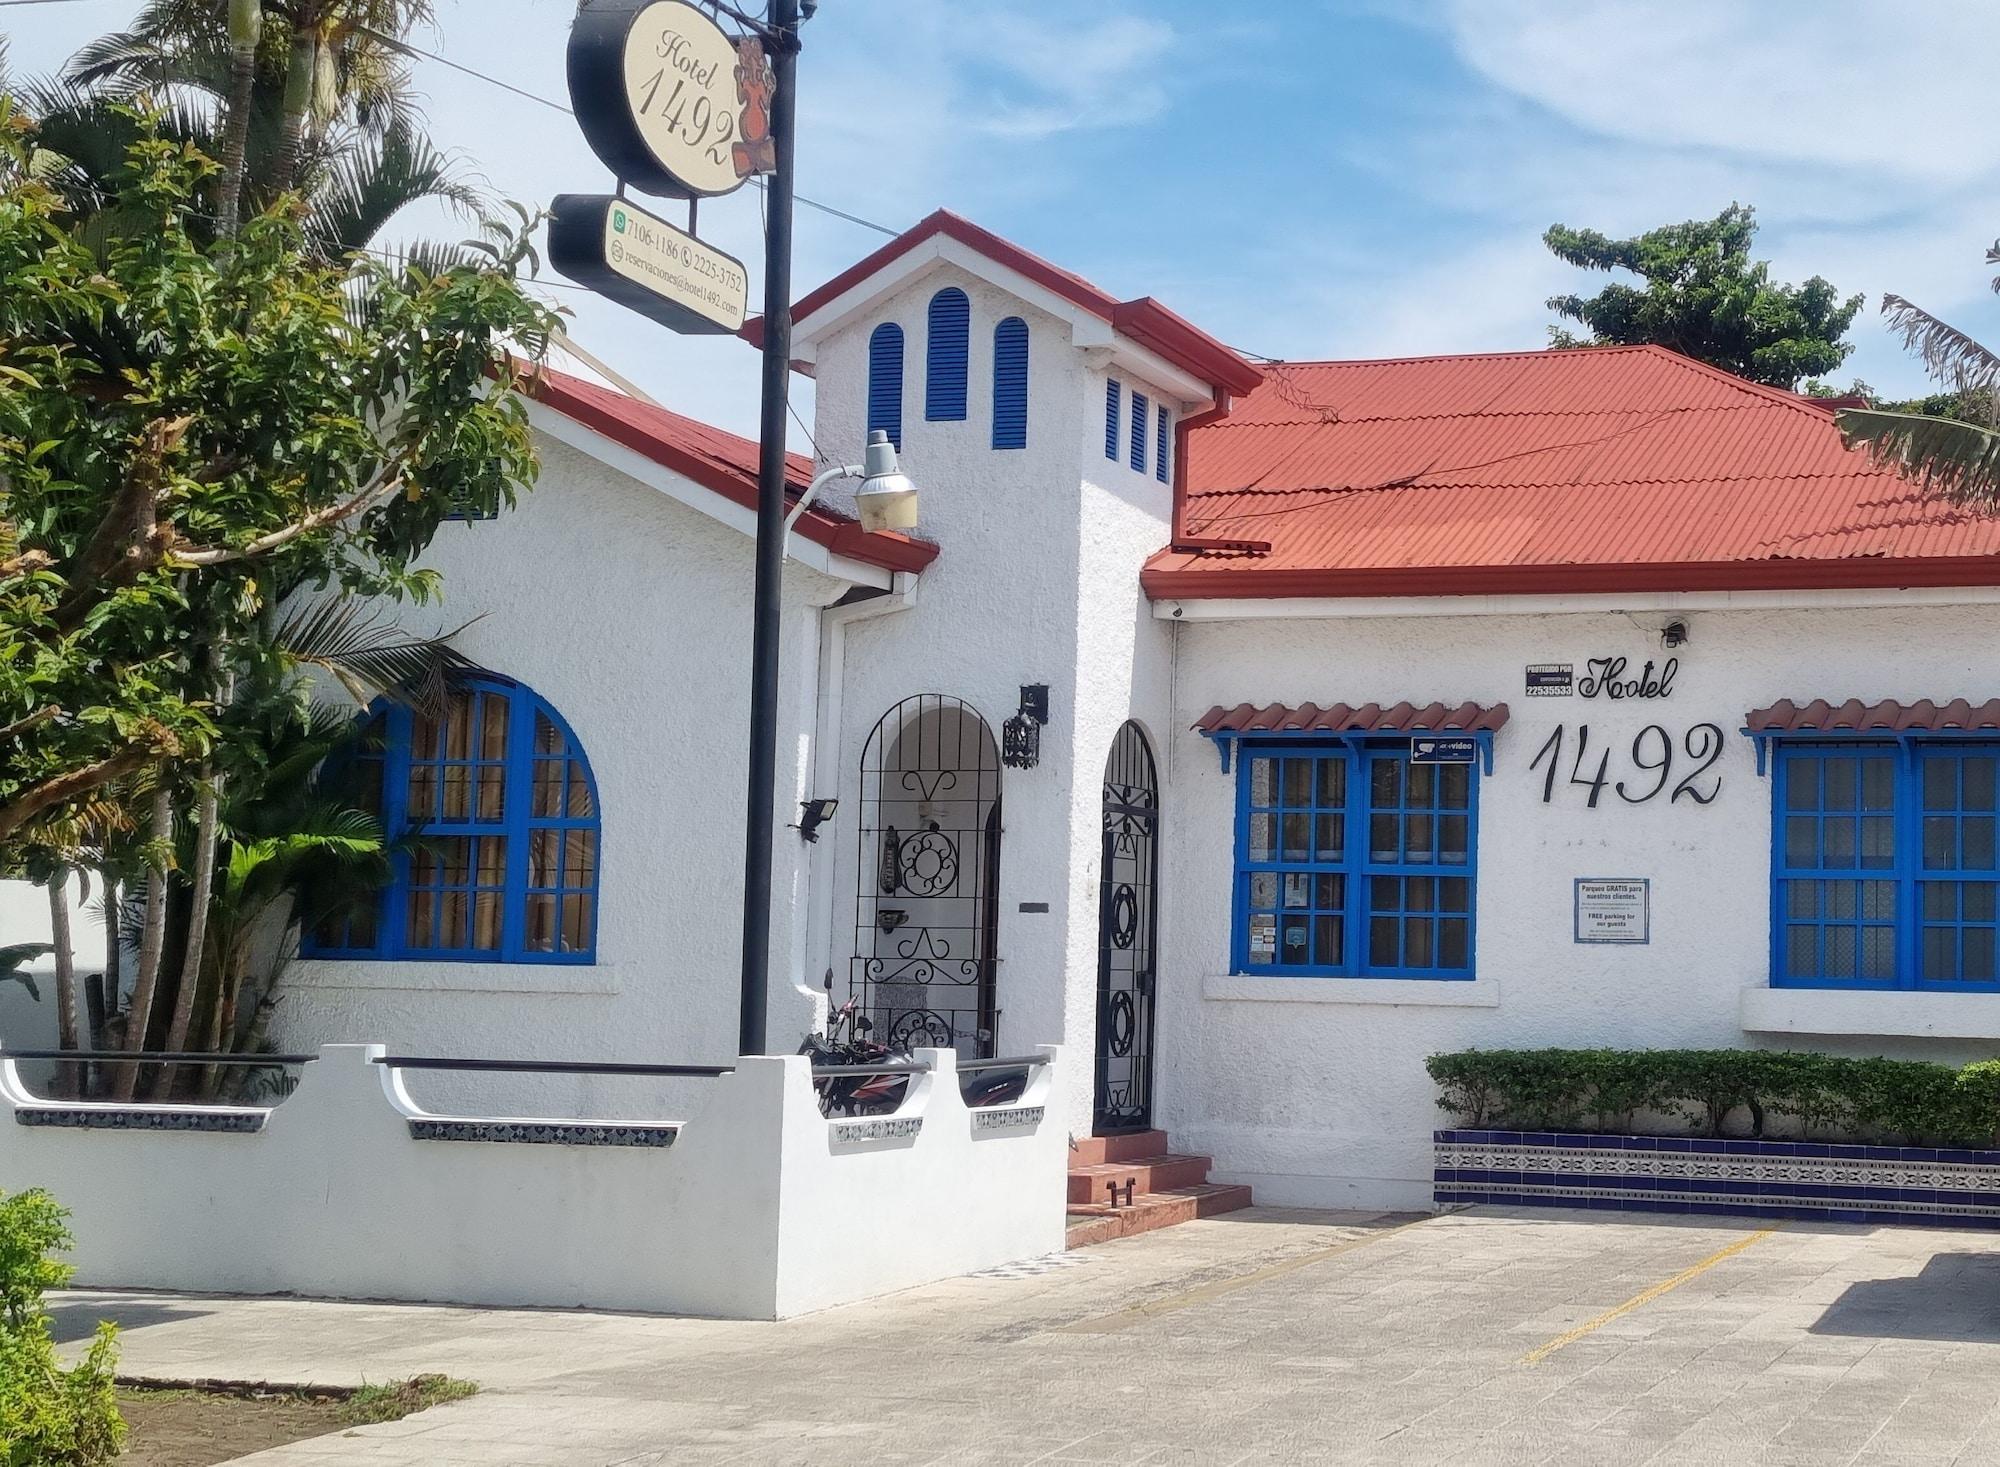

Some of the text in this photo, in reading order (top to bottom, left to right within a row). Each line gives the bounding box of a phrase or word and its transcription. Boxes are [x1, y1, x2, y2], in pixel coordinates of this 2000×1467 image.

[656, 29, 719, 90] Hotel
[640, 67, 734, 166] 1492
[624, 250, 738, 317] reservaciones@hotel1492.com
[627, 218, 742, 293] 7106-1186 2225-3752
[1526, 685, 1572, 696] 22535533
[1527, 665, 1560, 673] PROTEGIDO
[1578, 656, 1679, 700] Hotel
[1529, 722, 1724, 808] 1492
